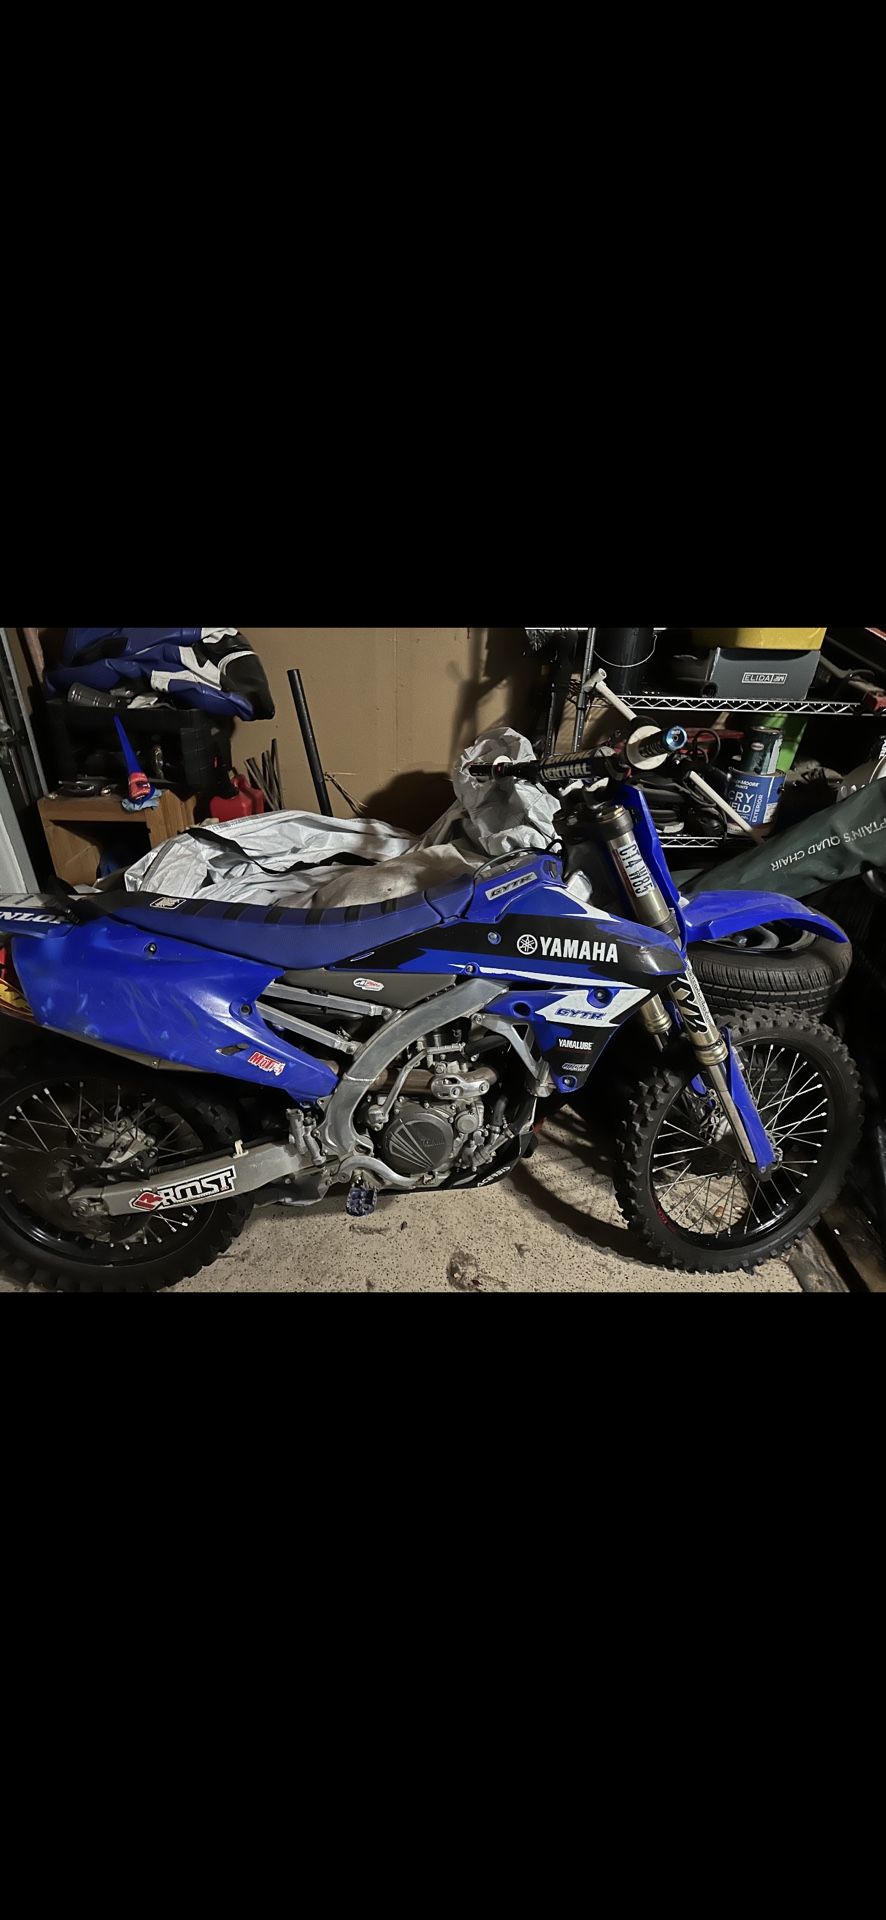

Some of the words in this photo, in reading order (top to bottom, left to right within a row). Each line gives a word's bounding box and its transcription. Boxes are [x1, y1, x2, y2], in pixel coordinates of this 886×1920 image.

[745, 674, 770, 682] ELIDA
[752, 794, 764, 823] EXTERIOR
[807, 835, 841, 855] QUAD
[770, 850, 805, 872] CHAIR
[539, 936, 619, 964] YAMAHA
[554, 1008, 607, 1020] GYTR
[558, 1039, 595, 1051] YAMALUBE
